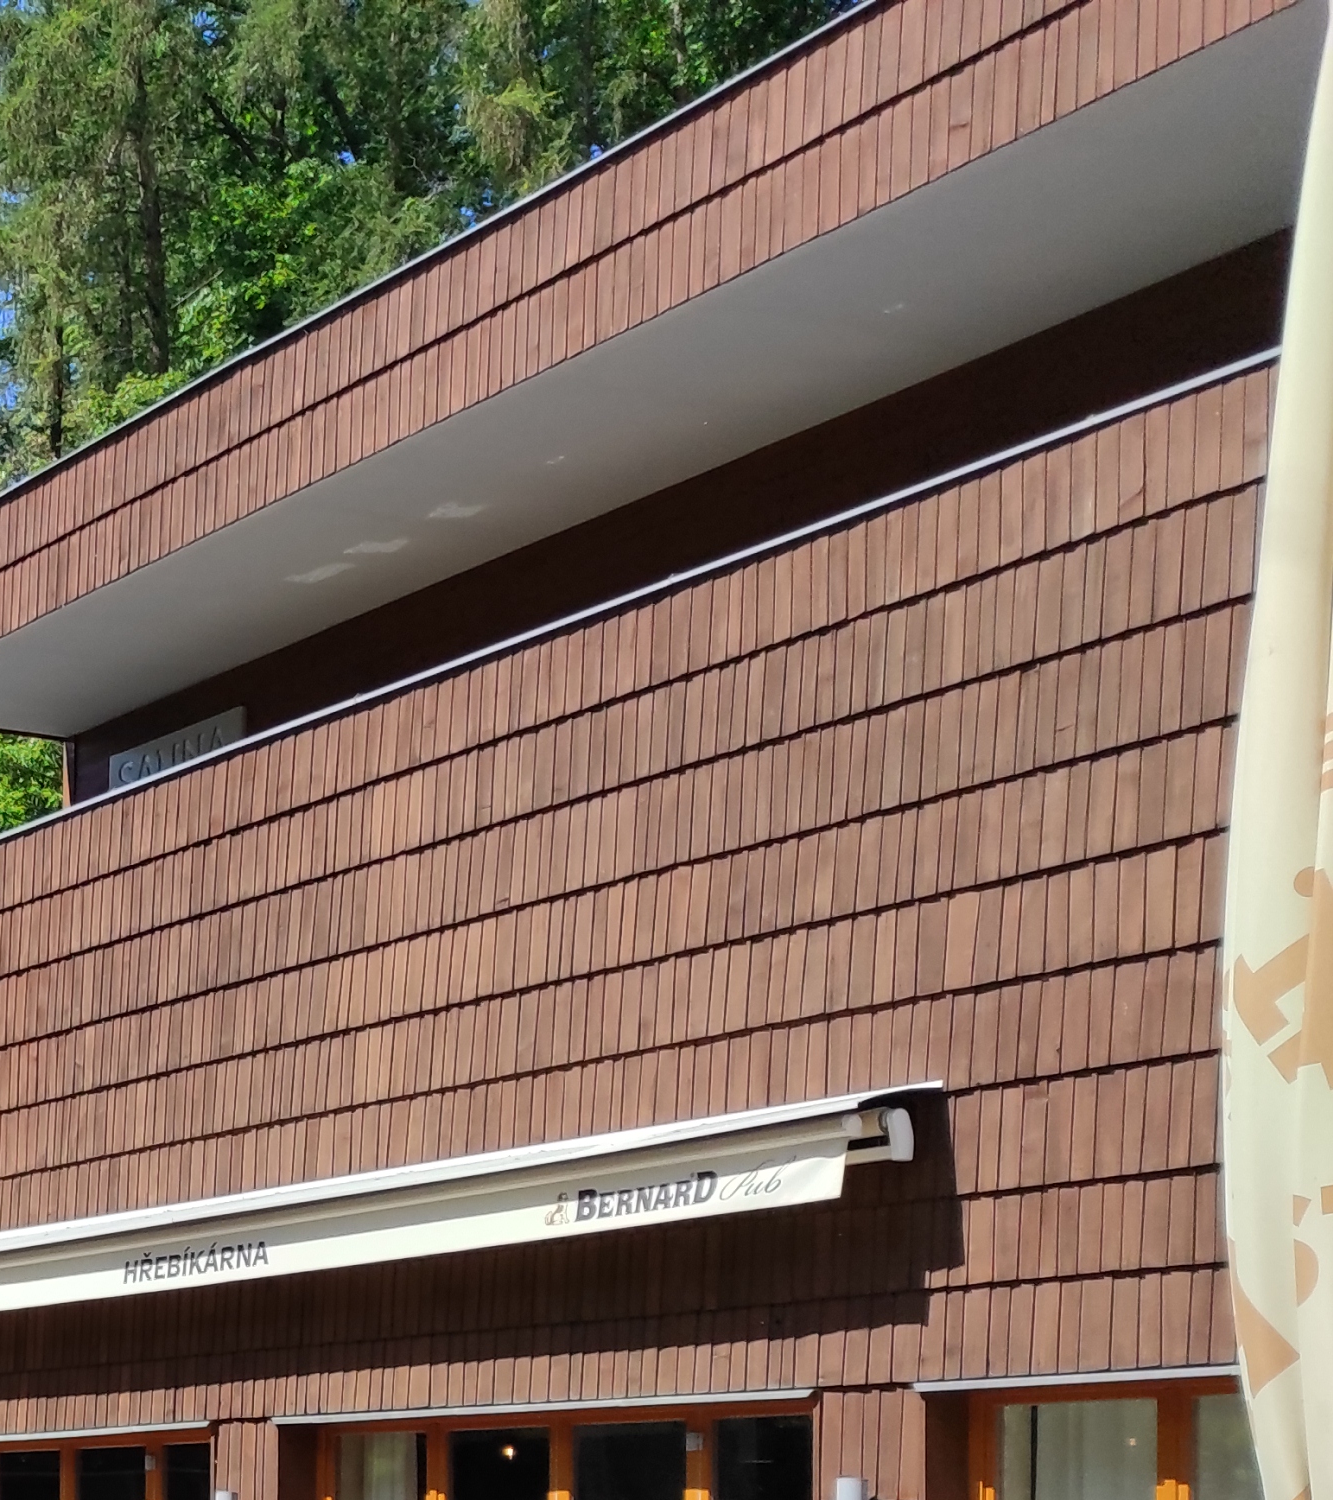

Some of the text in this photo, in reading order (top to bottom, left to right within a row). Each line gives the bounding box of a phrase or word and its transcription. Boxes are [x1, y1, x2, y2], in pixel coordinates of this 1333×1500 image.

[574, 1155, 797, 1223] BERNARD Pub
[122, 1241, 270, 1285] HŘEBÍKÁRNA
